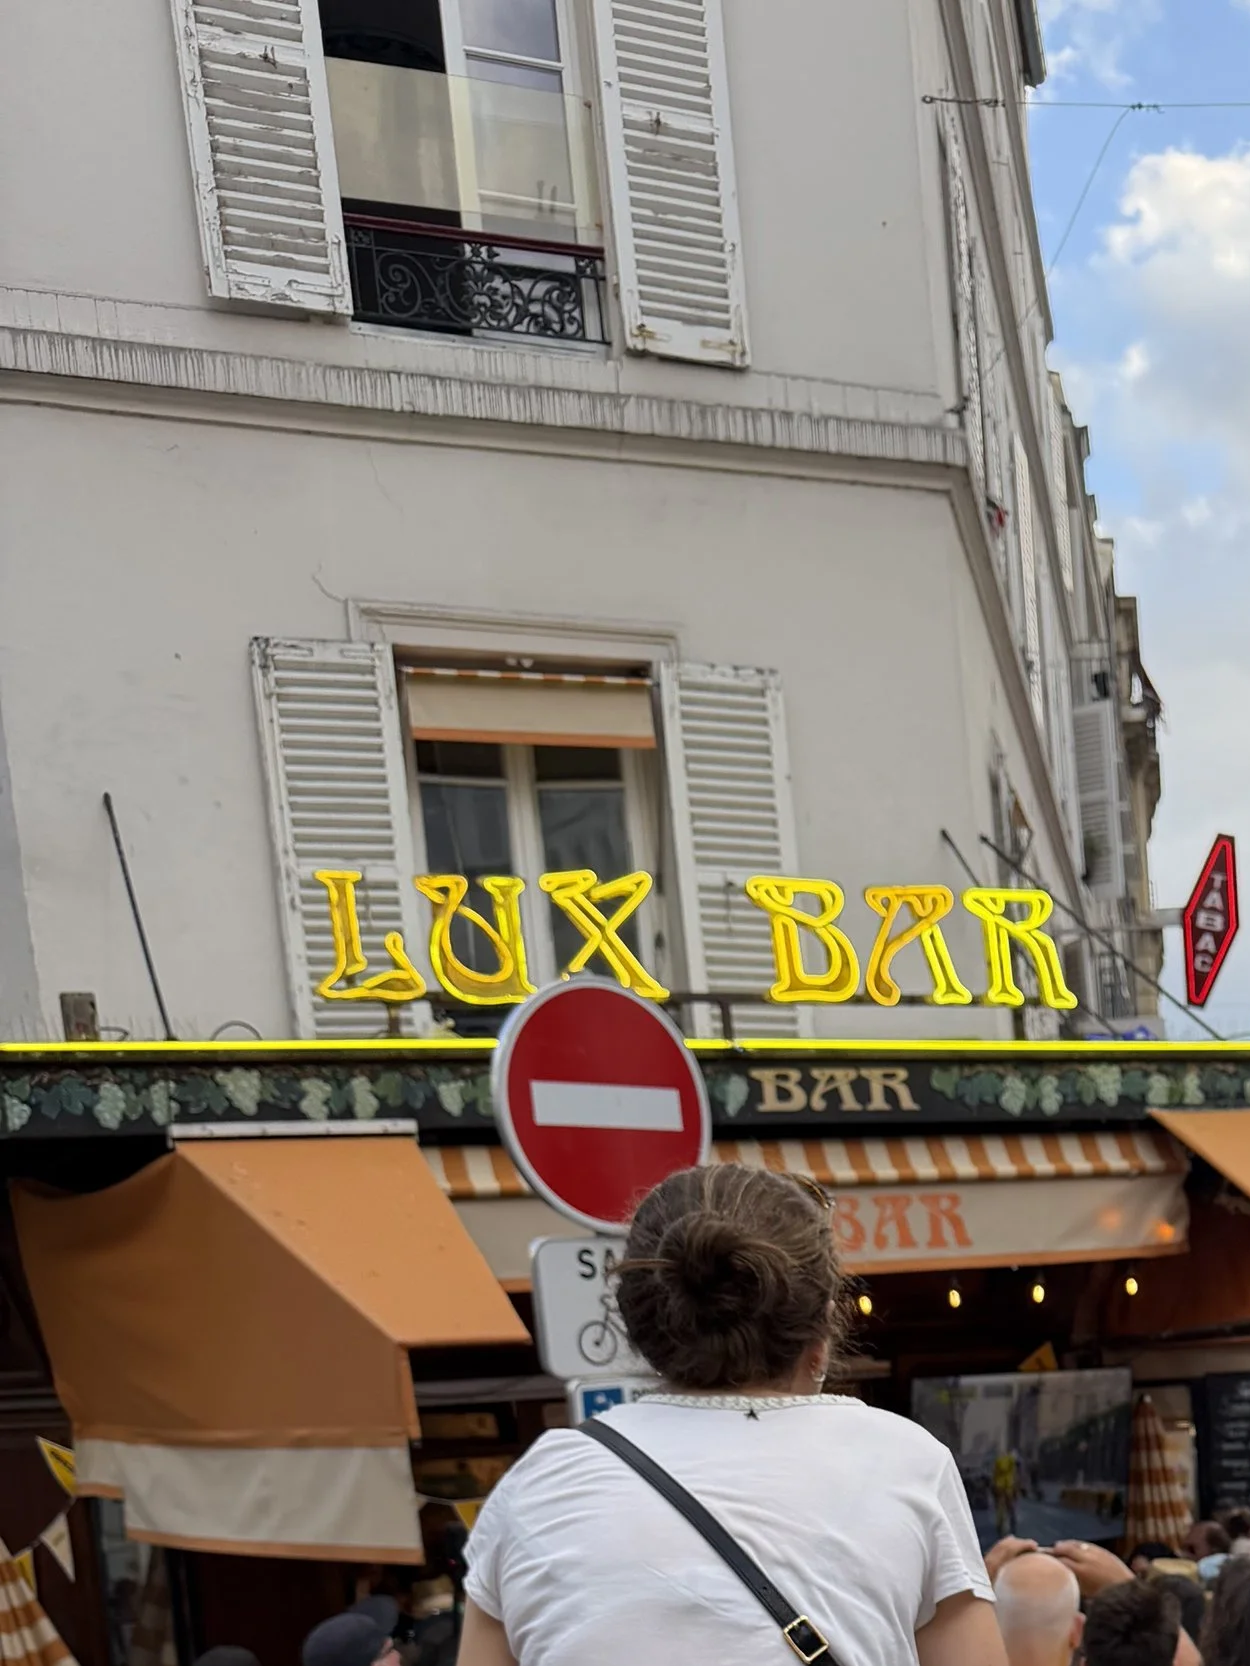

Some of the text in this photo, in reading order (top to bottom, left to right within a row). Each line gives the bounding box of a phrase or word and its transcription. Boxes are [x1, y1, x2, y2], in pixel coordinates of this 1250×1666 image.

[313, 868, 1078, 1010] LUX BAR
[1193, 871, 1227, 974] TABAC
[749, 1067, 920, 1113] BAR
[834, 1192, 973, 1250] BAR
